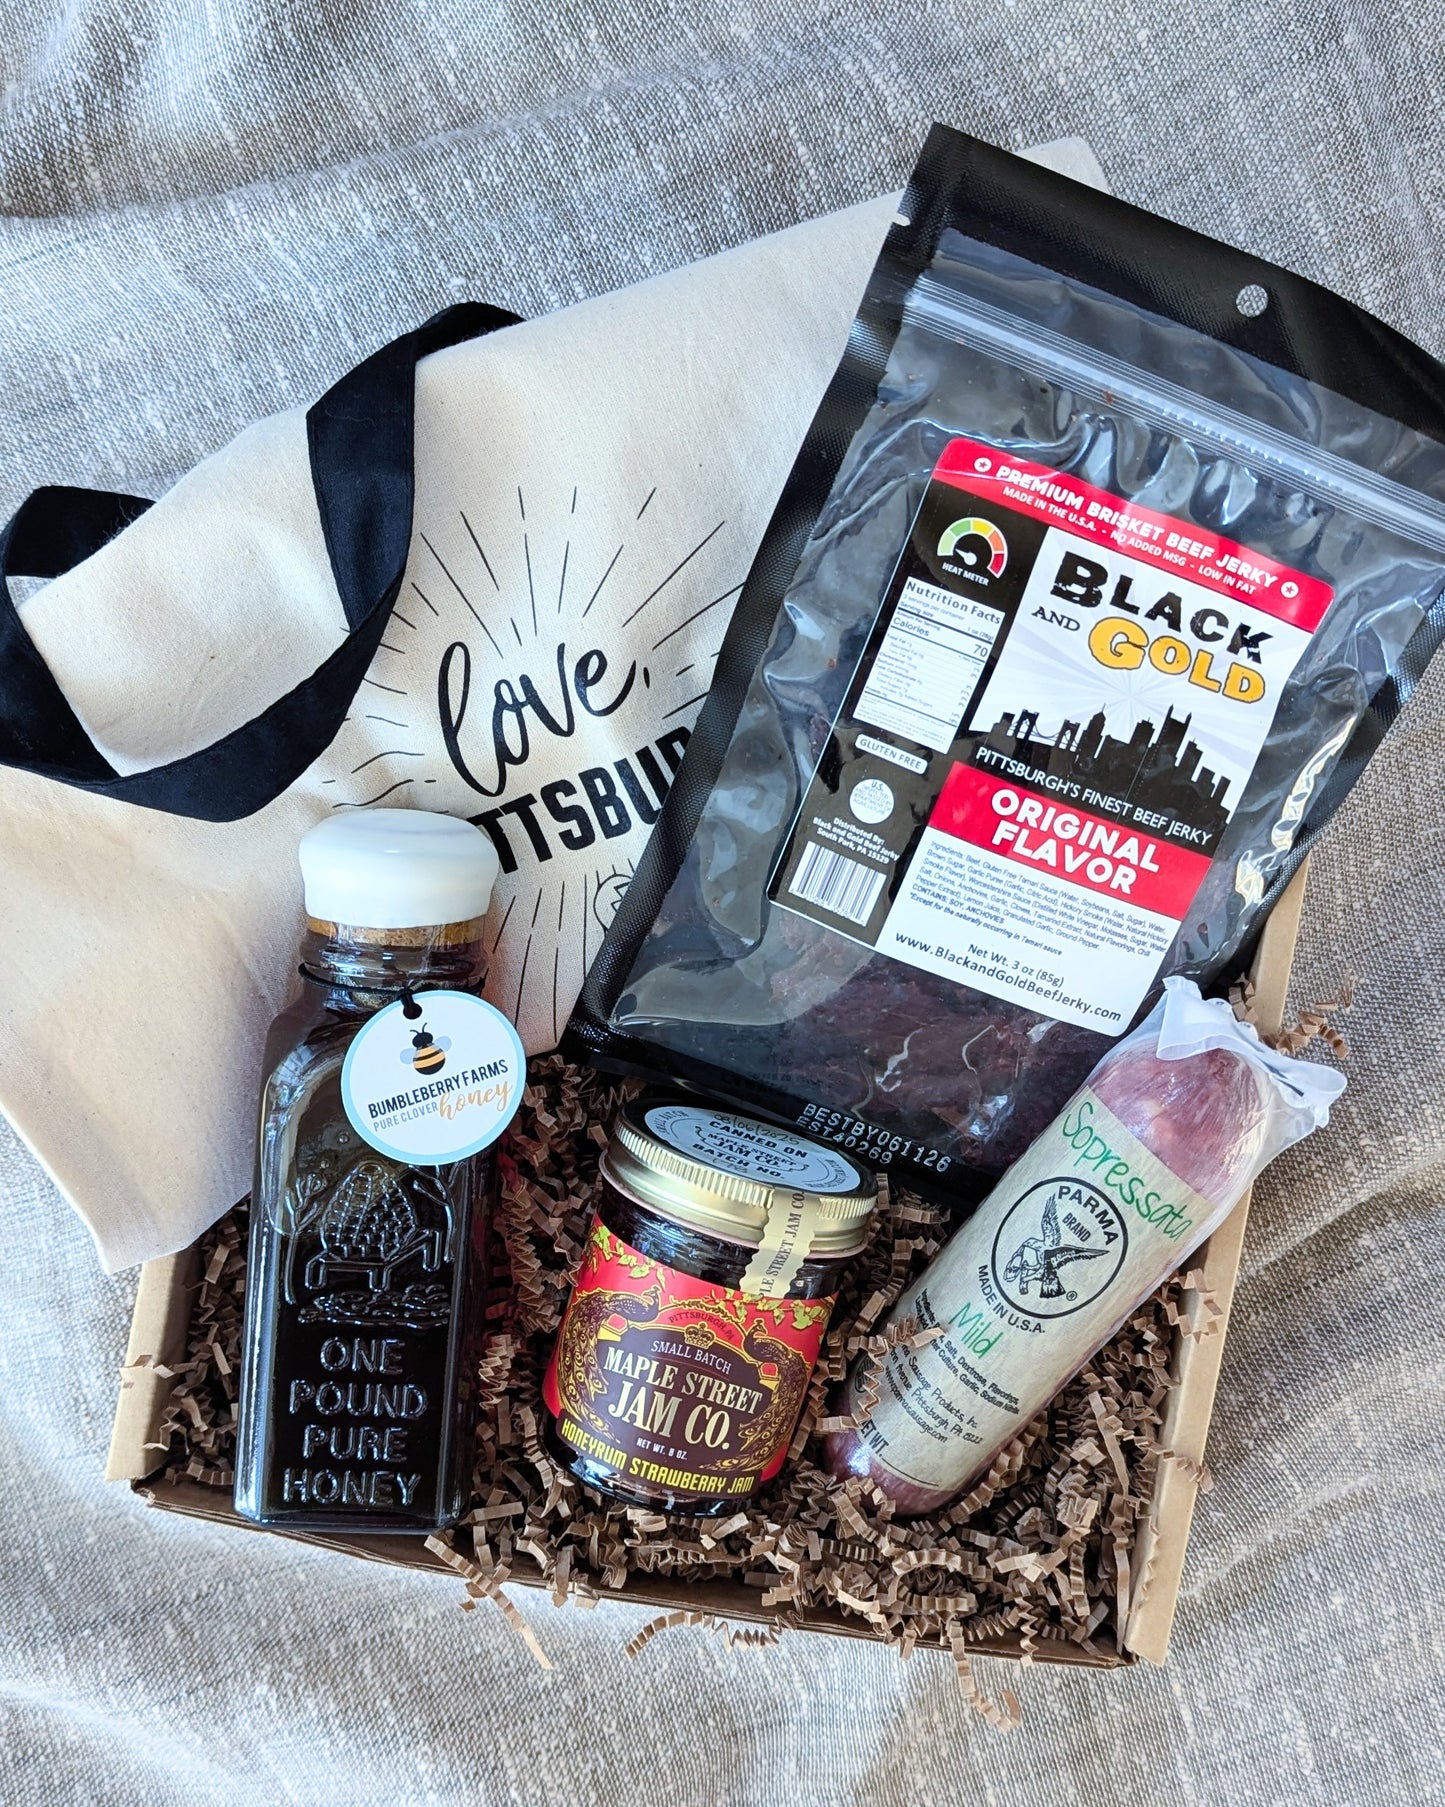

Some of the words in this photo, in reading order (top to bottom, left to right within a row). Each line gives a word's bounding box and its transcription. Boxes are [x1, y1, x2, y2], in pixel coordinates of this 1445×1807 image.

[994, 463, 1085, 511] PREMIUM
[1085, 501, 1163, 543] BRISKET
[1163, 532, 1214, 563] BEEF
[1212, 552, 1279, 590] JERKY
[1001, 485, 1035, 506] MADE
[1033, 498, 1047, 511] IN
[1045, 502, 1068, 519] THE
[1066, 512, 1099, 532] U.S.A.
[1108, 529, 1127, 544] NO
[1125, 535, 1163, 558] ADDED
[1161, 549, 1187, 567] MSG
[1196, 563, 1224, 582] LOW
[1221, 573, 1235, 587] IN
[1233, 578, 1257, 596] FAT
[941, 561, 963, 576] HEAT
[961, 569, 990, 586] METER
[905, 580, 970, 612] Nutrition
[969, 604, 1002, 625] Facts
[1030, 603, 1082, 633] AND
[1048, 551, 1273, 665] BLACK
[892, 615, 931, 637] Calories
[971, 643, 989, 658] 70
[1088, 616, 1266, 704] GOLD
[438, 641, 650, 797] love,
[858, 737, 898, 759] GLUTEN
[897, 753, 922, 769] FREE
[973, 745, 1082, 799] PITTSBURGH'S
[1080, 786, 1133, 818] FINEST
[1131, 806, 1168, 831] BEEF
[1163, 818, 1213, 850] JERKY
[812, 816, 833, 830] Black
[831, 824, 847, 836] and
[845, 830, 865, 844] Gold
[862, 838, 882, 852] Beef
[878, 846, 900, 862] Jerky
[815, 827, 839, 842] South
[836, 836, 857, 851] Park,
[855, 844, 868, 855] PA
[831, 816, 874, 839] Distributed
[986, 784, 1168, 873] ORIGINAL
[989, 819, 1140, 895] FLAVOR
[911, 883, 949, 903] CONTAINS:
[947, 898, 966, 910] SOY,
[964, 904, 1005, 924] ANCHOVIES
[892, 930, 1123, 1025] www.BlackandGoldBeefJerky.com
[966, 943, 989, 959] Net
[988, 951, 1011, 967] Wt.
[1010, 959, 1021, 971] 3
[1020, 964, 1035, 976] oz
[1033, 968, 1066, 989] (85g)
[367, 1074, 461, 1119] BUMBLEBERRY
[462, 1059, 509, 1087] FARMS
[373, 1115, 400, 1132] PURE
[400, 1101, 439, 1123] CLOVER
[438, 1080, 513, 1120] honey
[690, 1142, 750, 1167] BATCH
[755, 1165, 785, 1179] NO.
[707, 1119, 778, 1148] CANNED
[782, 1145, 808, 1158] ON
[712, 1139, 752, 1158] JAM
[753, 1153, 782, 1168] CO.
[796, 1115, 893, 1165] EST40269
[803, 1103, 951, 1173] BESTBY061126
[1063, 1101, 1194, 1242] Sopressata
[792, 1191, 805, 1209] CO.
[1057, 1185, 1119, 1246] PARMA
[785, 1213, 802, 1238] JAM
[1062, 1212, 1092, 1242] BRAND
[766, 1240, 794, 1276] STREET
[978, 1264, 997, 1305] MADE
[993, 1302, 1008, 1319] IN
[1007, 1314, 1046, 1334] U.S.A.
[948, 1302, 1004, 1360] Mild
[320, 1336, 405, 1374] ONE
[650, 1340, 692, 1360] SMALL
[694, 1349, 732, 1375] BATCH
[957, 1356, 988, 1388] Dextrose,
[288, 1379, 428, 1419] POUND
[604, 1347, 678, 1390] MAPLE
[682, 1371, 763, 1415] STREET
[908, 1356, 932, 1392] Sausage
[931, 1387, 965, 1423] Products,
[608, 1380, 683, 1438] JAM
[684, 1404, 731, 1450] CO.
[302, 1424, 408, 1462] PURE
[561, 1417, 627, 1470] HONEYRUM
[629, 1457, 726, 1494] STRAWBERRY
[727, 1475, 755, 1493] JAM
[636, 1437, 650, 1448] NET
[653, 1442, 666, 1455] WT.
[676, 1448, 688, 1461] OZ.
[283, 1467, 421, 1506] HONEY
